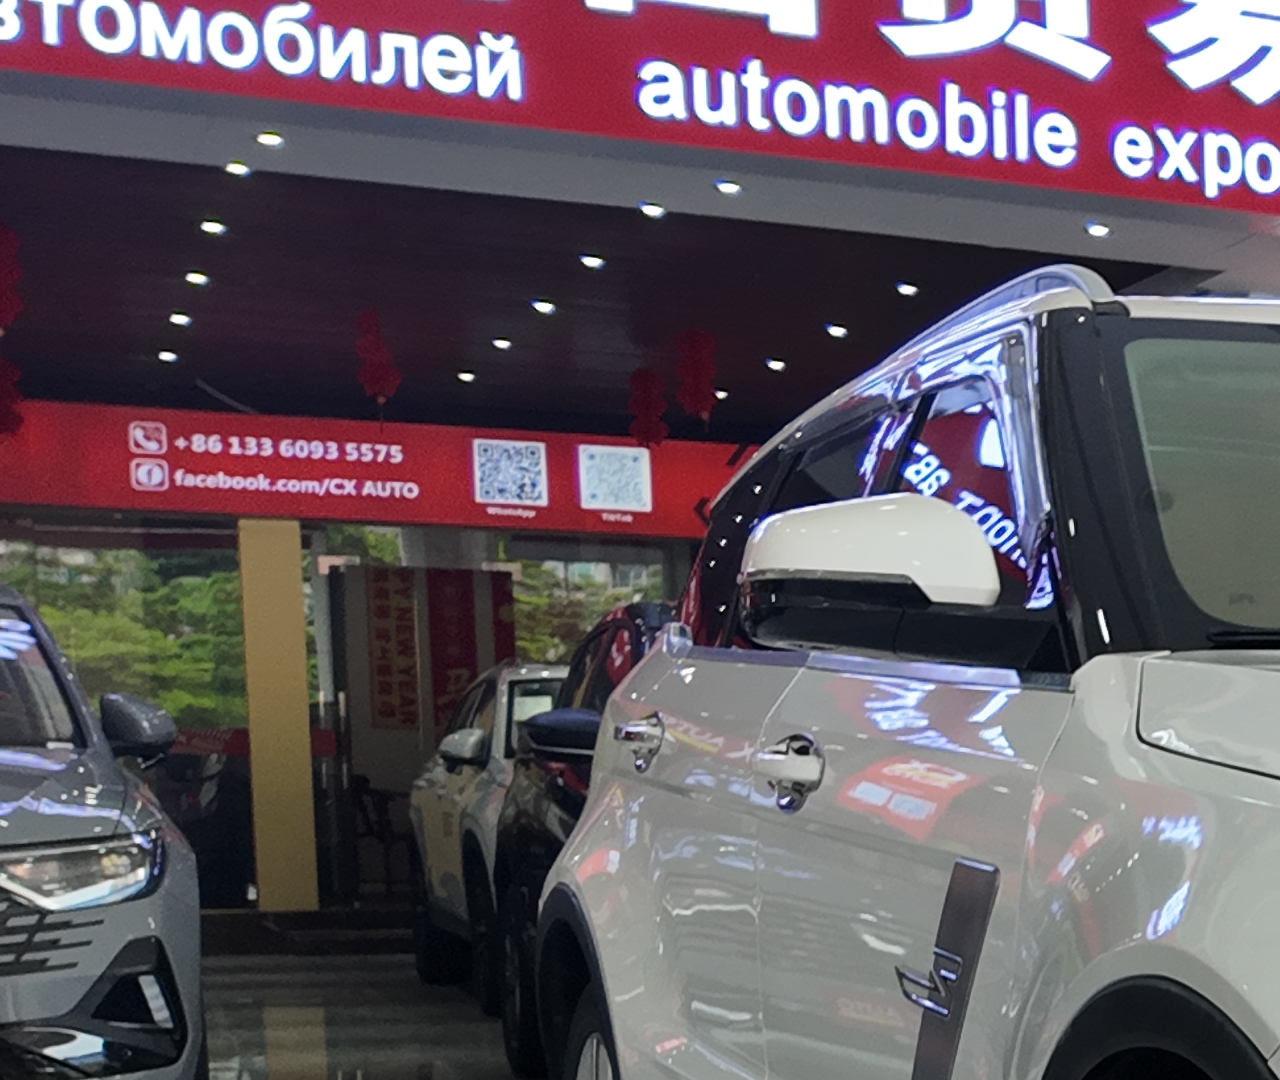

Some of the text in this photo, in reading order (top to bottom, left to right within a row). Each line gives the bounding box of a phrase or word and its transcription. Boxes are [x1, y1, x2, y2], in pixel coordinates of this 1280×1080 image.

[637, 57, 1079, 168] automobile
[174, 433, 404, 464] +86 133 6093 5575
[174, 468, 420, 499] facebook.com/CX AUTO
